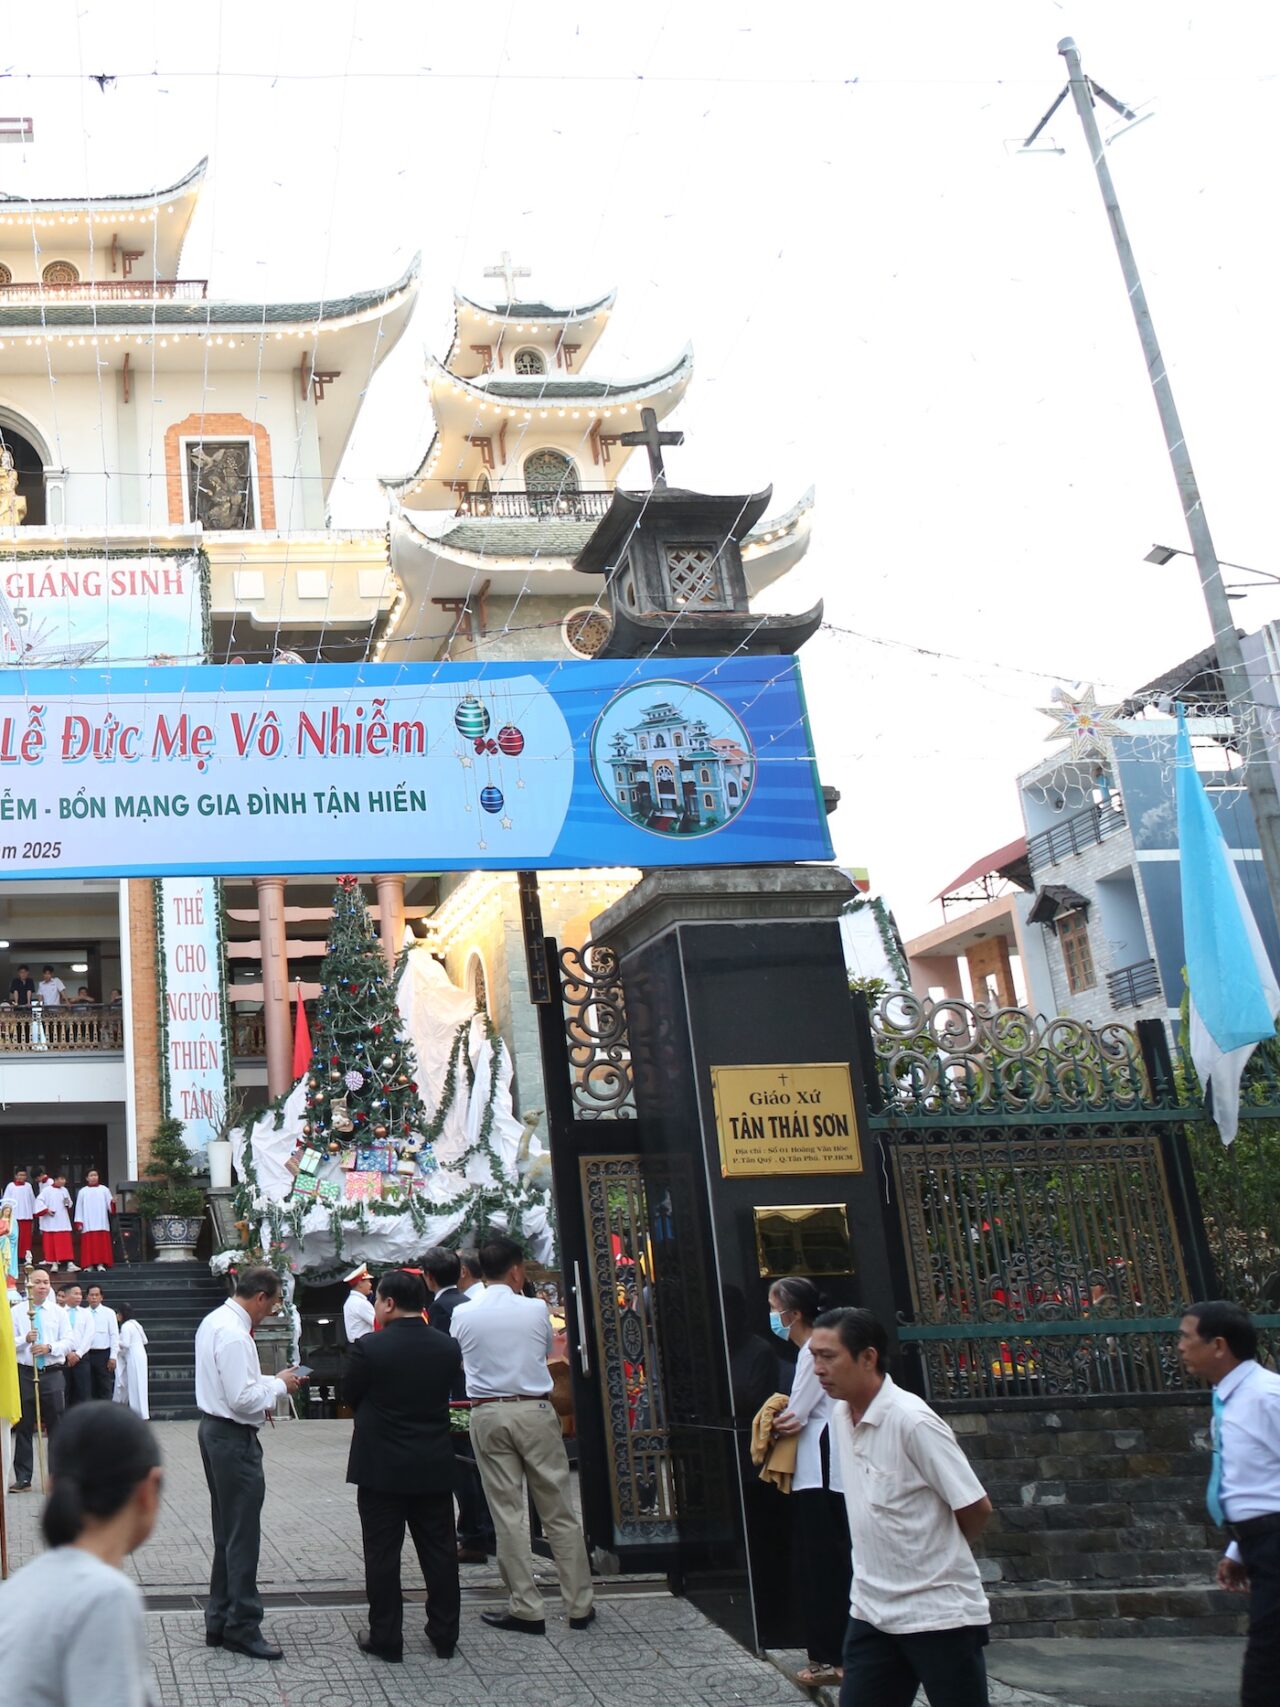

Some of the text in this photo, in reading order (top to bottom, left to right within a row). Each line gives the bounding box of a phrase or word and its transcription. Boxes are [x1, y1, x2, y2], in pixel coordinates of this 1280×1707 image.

[5, 565, 102, 599] GIÁNG
[111, 570, 185, 596] SINH
[0, 704, 46, 762] Lễ
[60, 712, 141, 760] Đức
[152, 713, 215, 771] Mẹ
[230, 711, 281, 757] Vô
[297, 698, 427, 756] Nhiễm
[58, 786, 107, 819] BỔN
[114, 794, 190, 823] MẠNG
[197, 793, 241, 817] GIA
[247, 785, 308, 816] ĐÌNH
[313, 782, 360, 819] TẬN
[368, 781, 427, 813] HIẾN
[22, 841, 62, 860] 2025
[173, 888, 205, 926] THẾ
[175, 944, 207, 973] CHO
[166, 984, 219, 1021] NGƯỜI
[171, 1033, 219, 1078] THIỆN
[180, 1082, 214, 1120] TÂM
[749, 1089, 822, 1106] Giáo Xứ
[729, 1110, 850, 1140] TÂN THÁI SƠN
